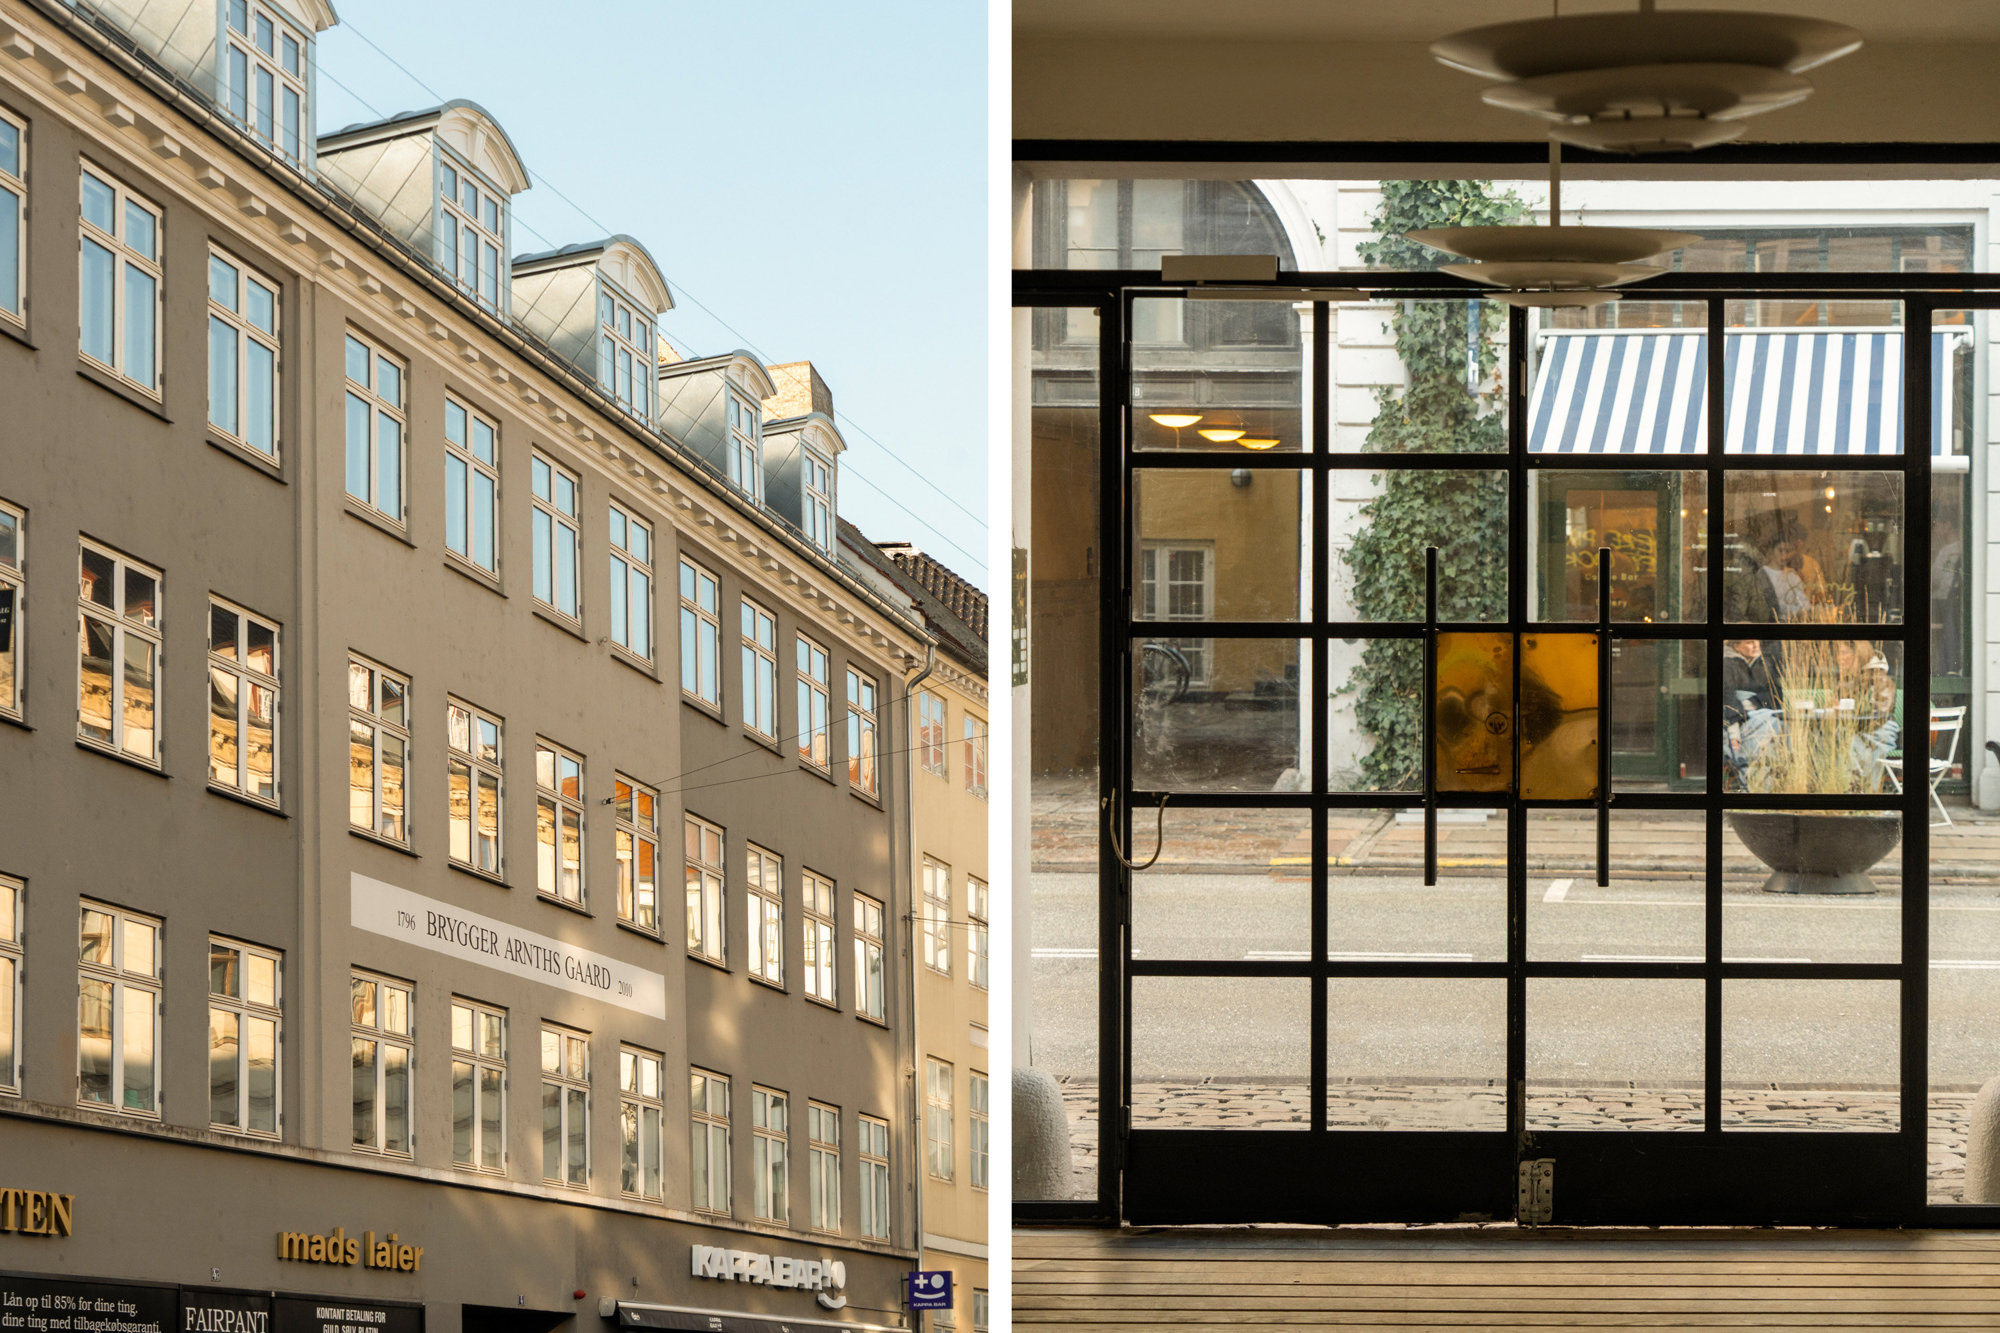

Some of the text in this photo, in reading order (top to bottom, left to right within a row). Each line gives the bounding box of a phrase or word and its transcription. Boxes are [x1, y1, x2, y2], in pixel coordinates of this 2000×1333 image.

[397, 910, 416, 931] 1796
[426, 910, 500, 957] BRYGGER
[504, 936, 561, 976] ARNTHS
[565, 955, 611, 990] GAARD
[277, 1227, 424, 1271] mads laier
[3, 1292, 138, 1317] Lån op til 85% for dine ting.
[316, 1306, 386, 1323] KONTANT BETALING FOR
[2, 1312, 25, 1327] dine
[27, 1314, 48, 1332] ting
[50, 1316, 71, 1330] med
[185, 1306, 269, 1333] FAIRPANT
